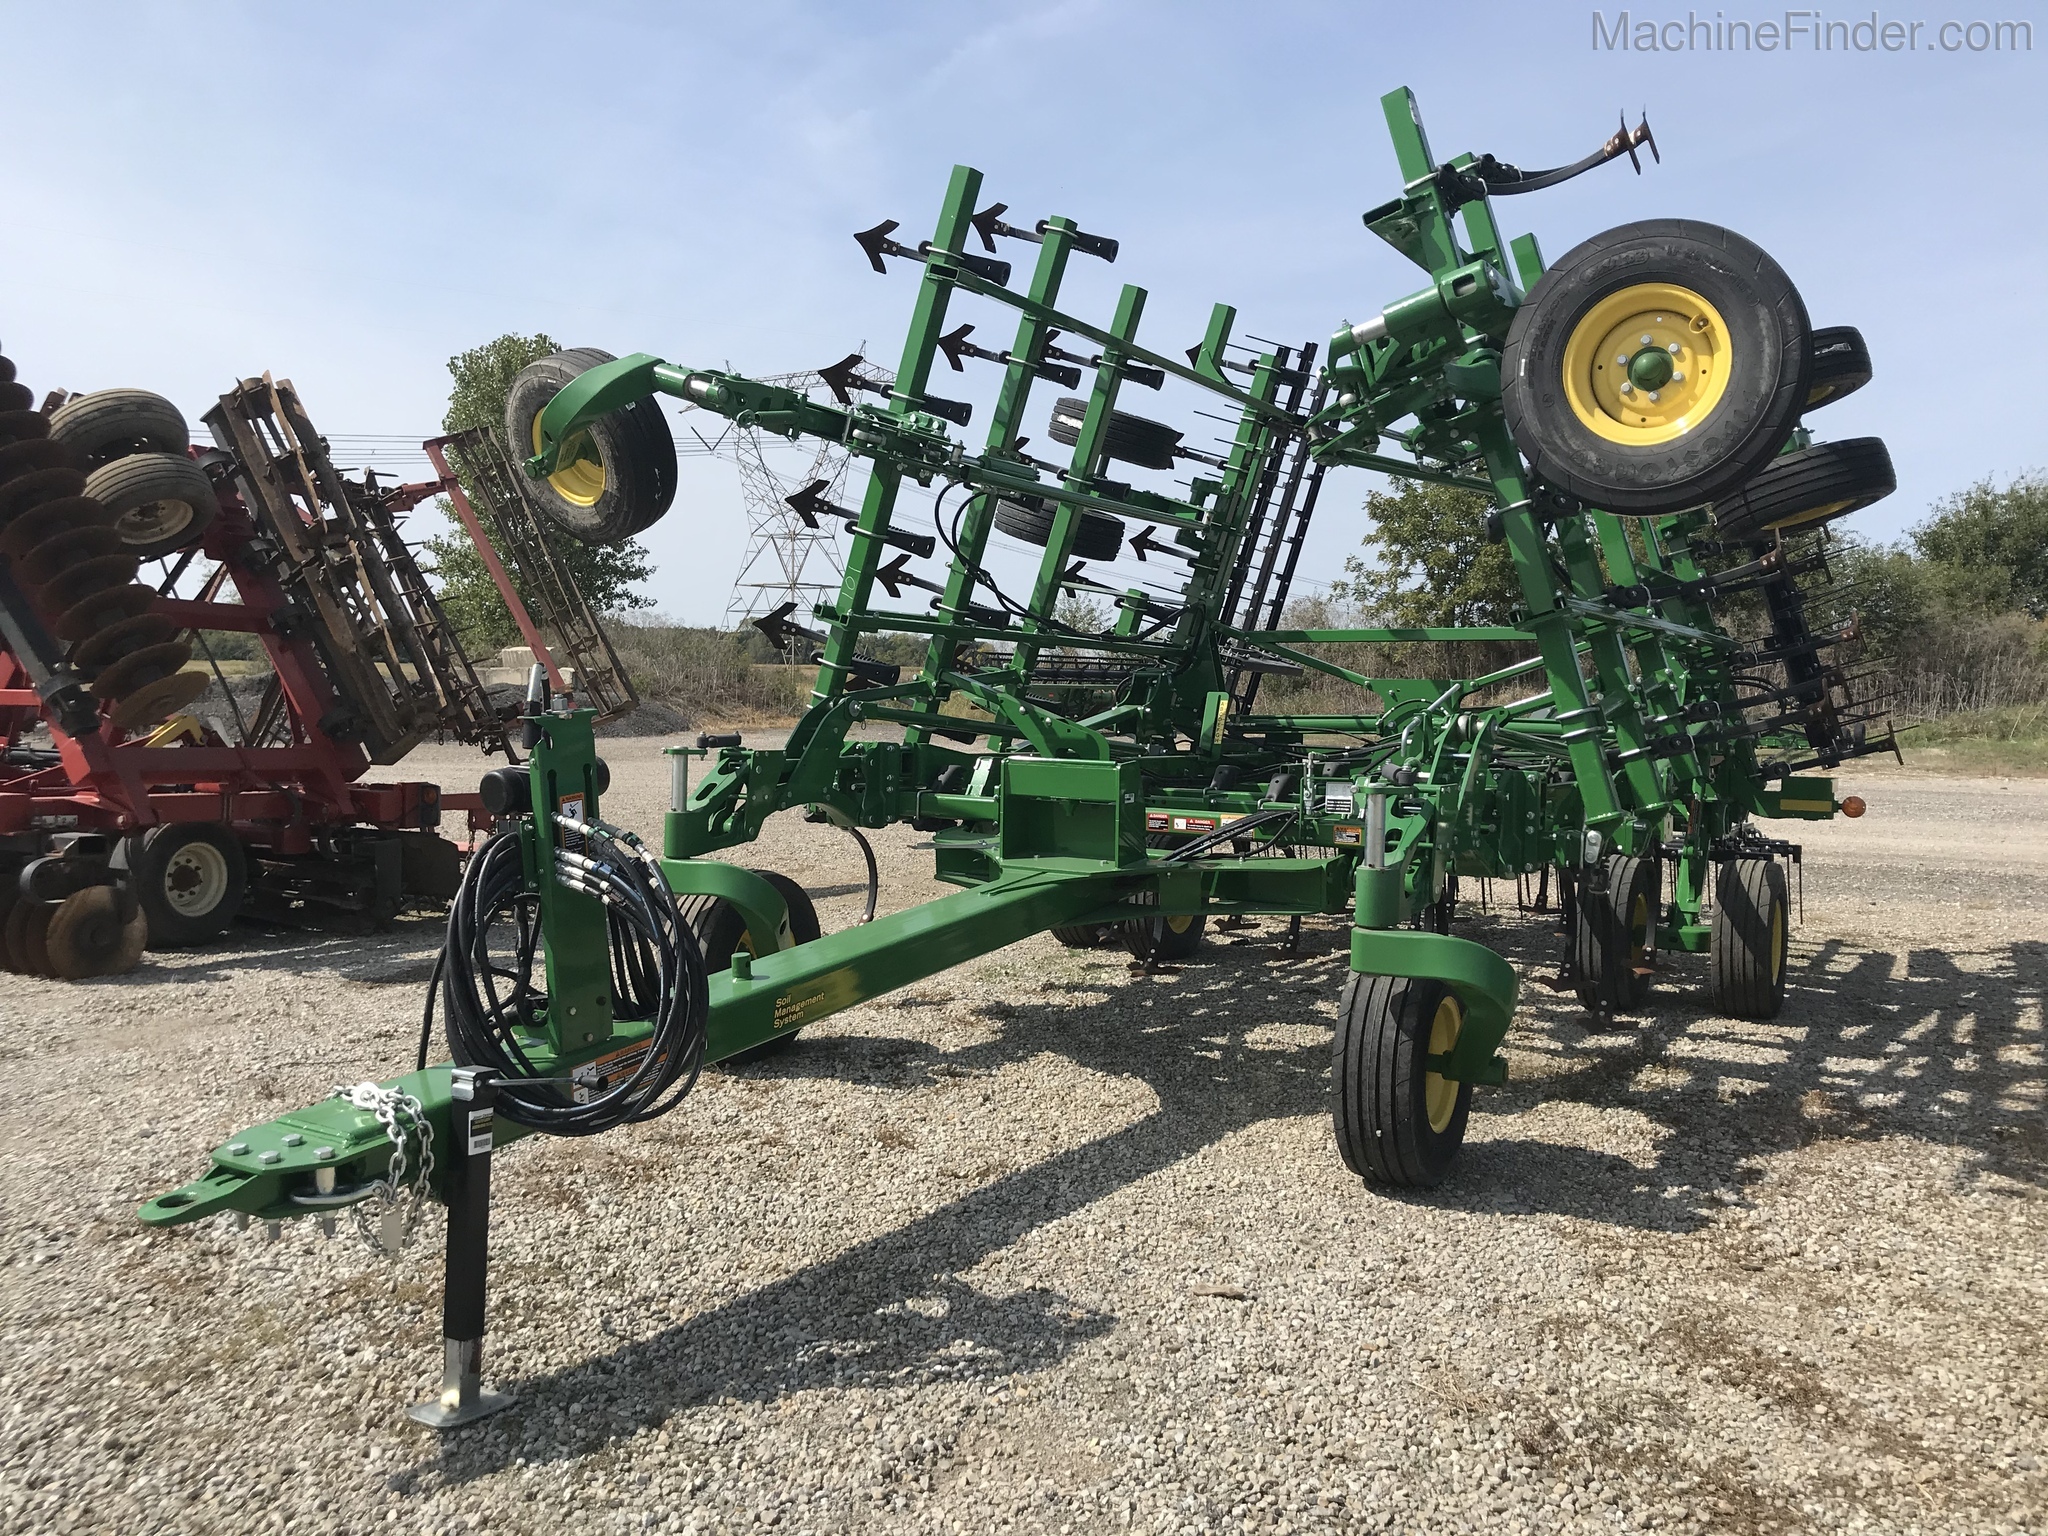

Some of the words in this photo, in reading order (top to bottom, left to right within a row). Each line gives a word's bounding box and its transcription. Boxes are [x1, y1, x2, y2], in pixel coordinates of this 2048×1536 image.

[774, 991, 825, 1018] Management
[775, 994, 792, 1008] Soil
[773, 1011, 804, 1028] System
